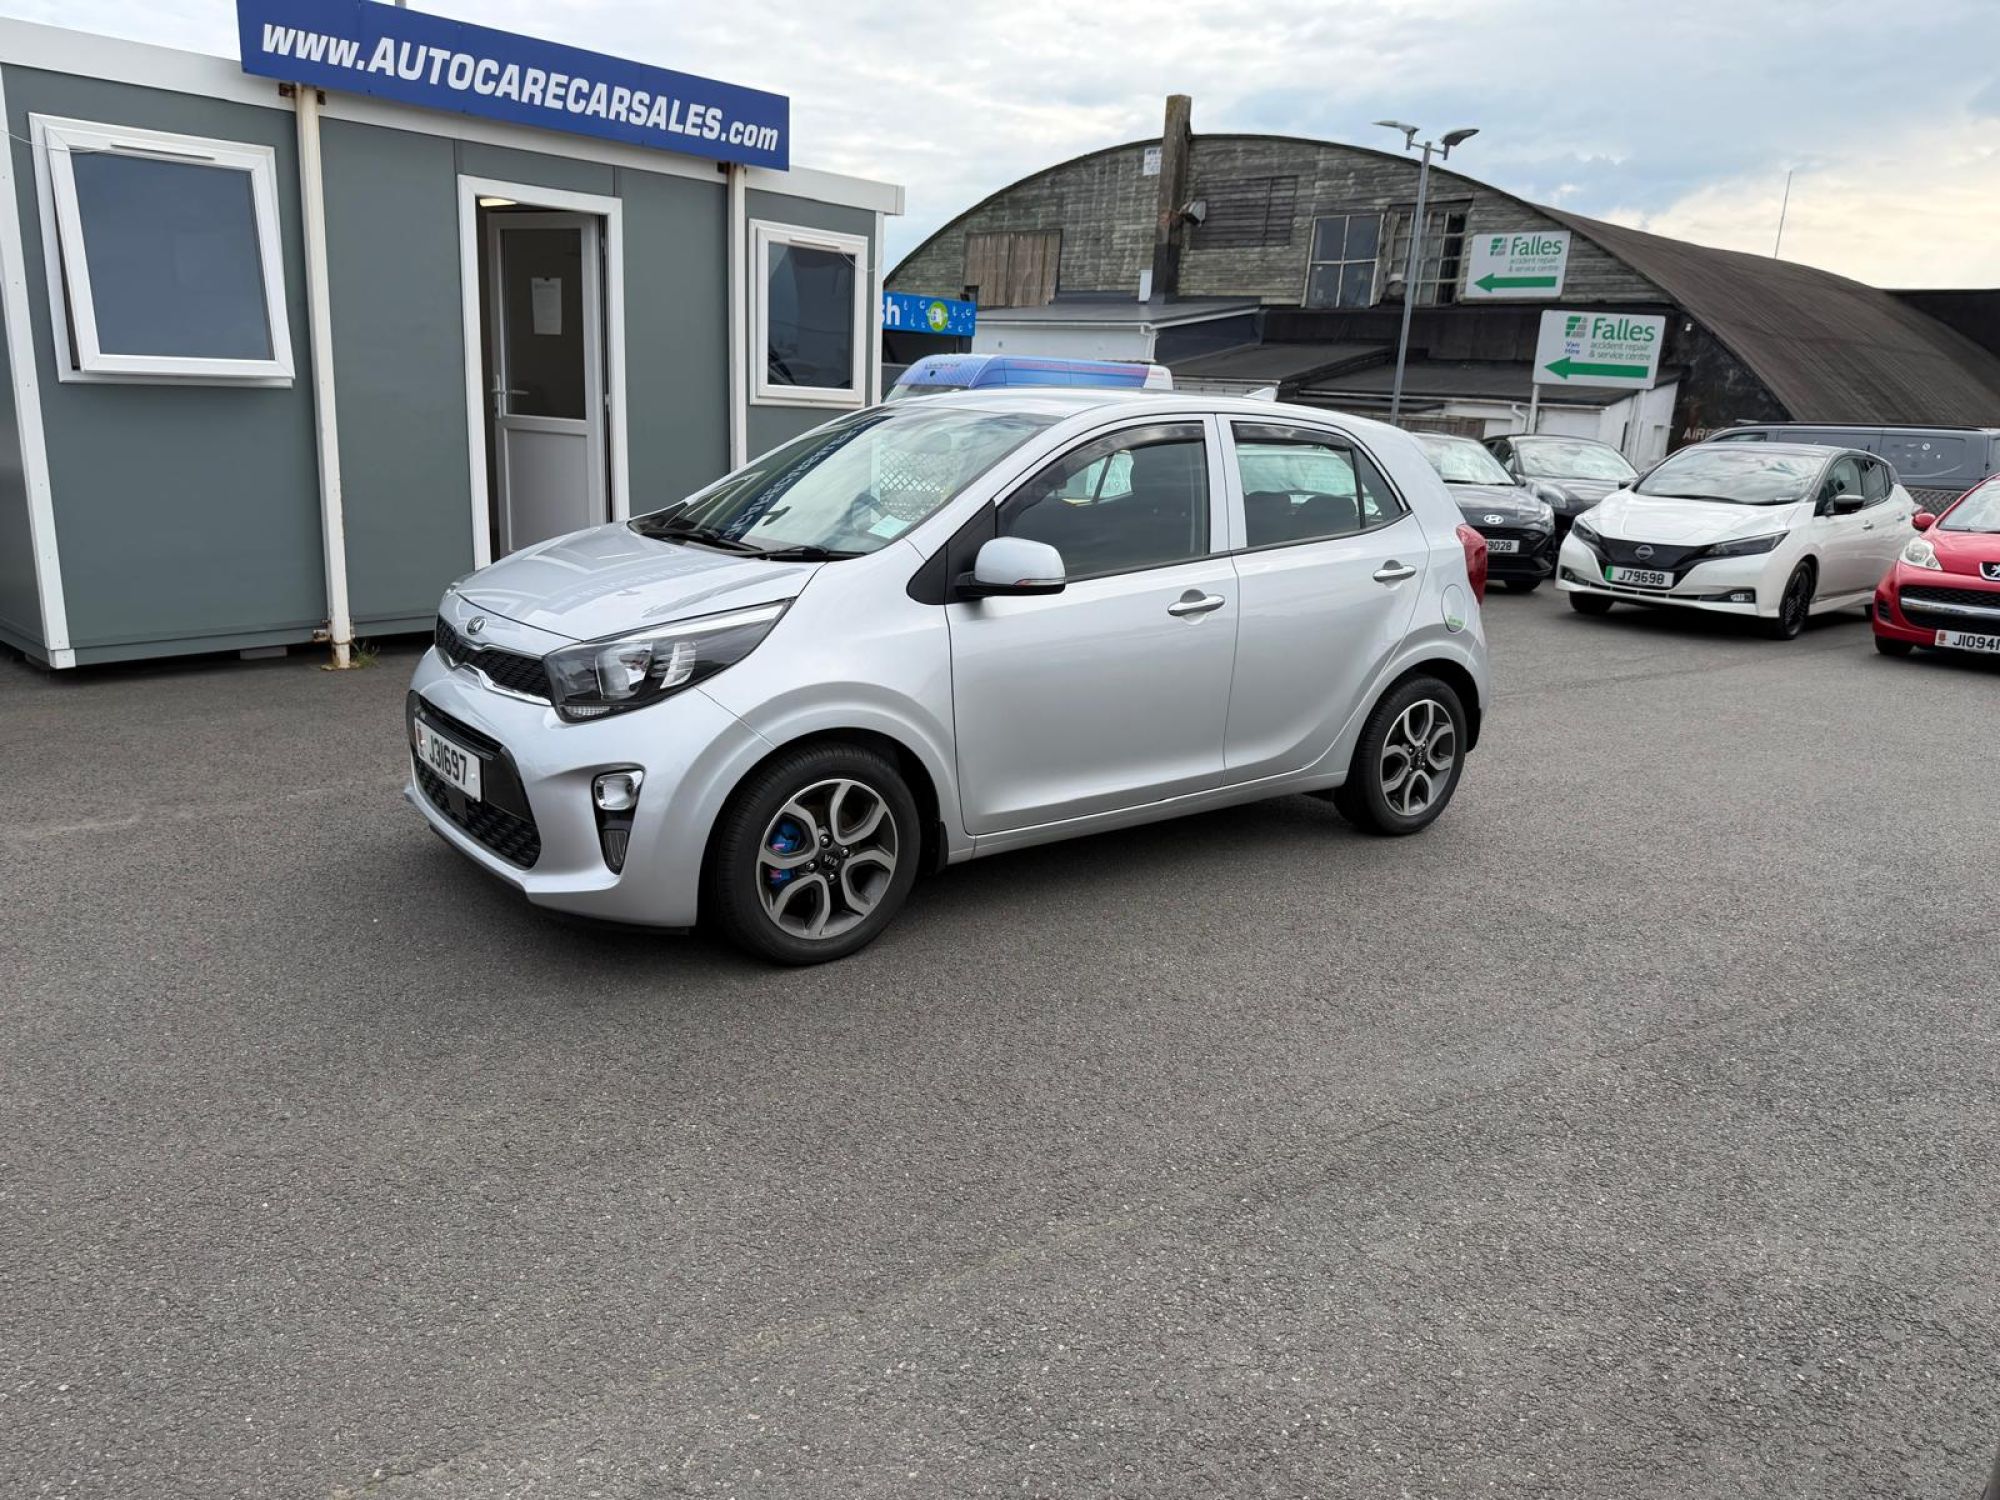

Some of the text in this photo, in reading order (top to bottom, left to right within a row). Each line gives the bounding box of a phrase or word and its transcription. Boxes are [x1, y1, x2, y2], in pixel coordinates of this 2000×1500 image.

[262, 23, 778, 151] www.AUTOCARECARSALES.com
[1510, 235, 1563, 256] Falles
[1592, 317, 1656, 342] Falles
[1590, 341, 1650, 351] accident repair
[1597, 351, 1624, 359] service
[1625, 352, 1651, 361] centre
[1618, 569, 1666, 585] J79698
[430, 734, 467, 786] J31697
